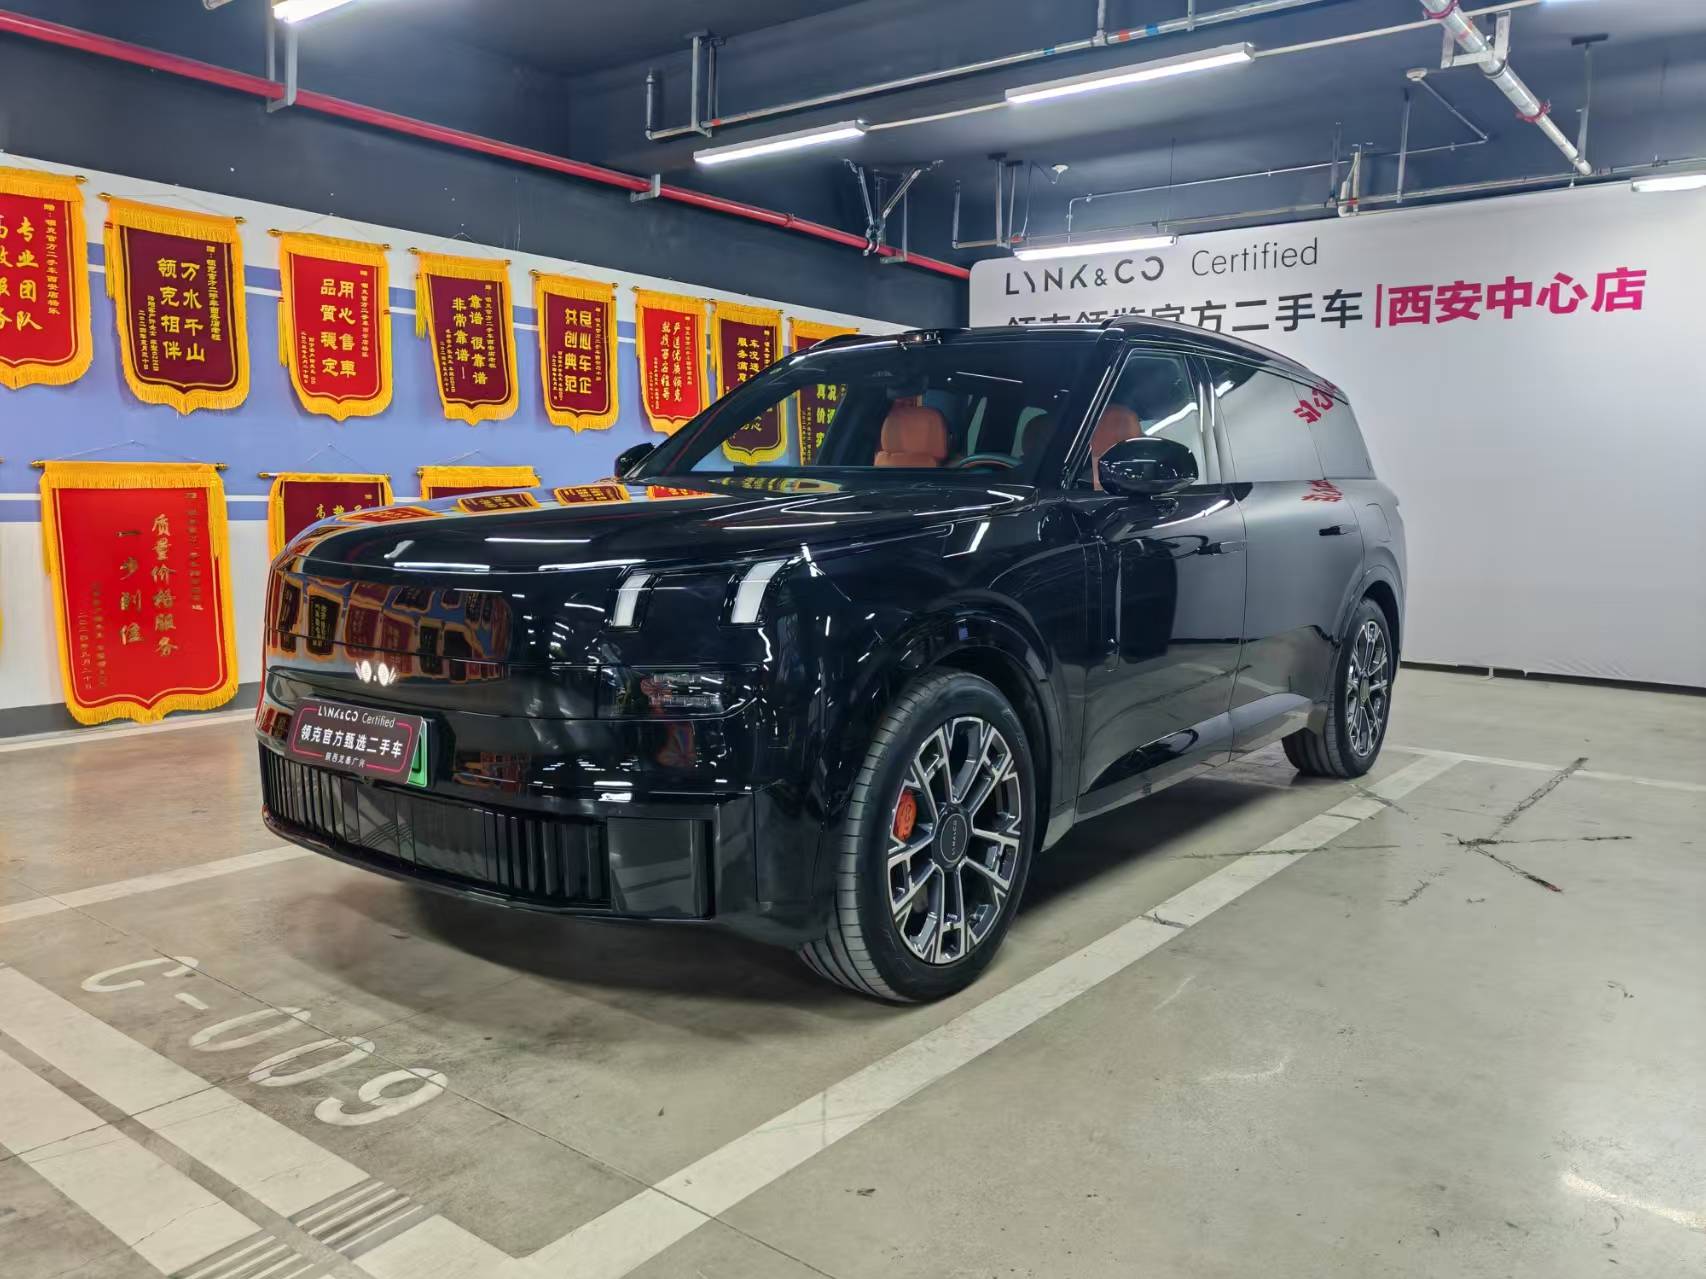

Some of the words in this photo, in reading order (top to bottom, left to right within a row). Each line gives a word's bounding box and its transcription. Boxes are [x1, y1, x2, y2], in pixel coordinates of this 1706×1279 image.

[16, 216, 43, 331] 专业团队
[1006, 255, 1165, 295] LYNK&CO
[1191, 237, 1319, 277] Certified
[1388, 267, 1649, 327] 西安中心店
[156, 257, 183, 361] 领克相伴
[180, 261, 206, 362] 万水千山
[337, 280, 357, 379] 用心售車
[468, 294, 484, 326] 靠谱
[564, 307, 578, 393] 共创典范
[470, 336, 488, 385] 很靠谱
[579, 310, 592, 394] 良心车企
[151, 513, 178, 657] 质量价格服务
[300, 723, 404, 759] 领克官方甄选二手车
[317, 705, 359, 722] LYNK&CO
[361, 712, 396, 728] Certified
[80, 955, 448, 1127] C-009
